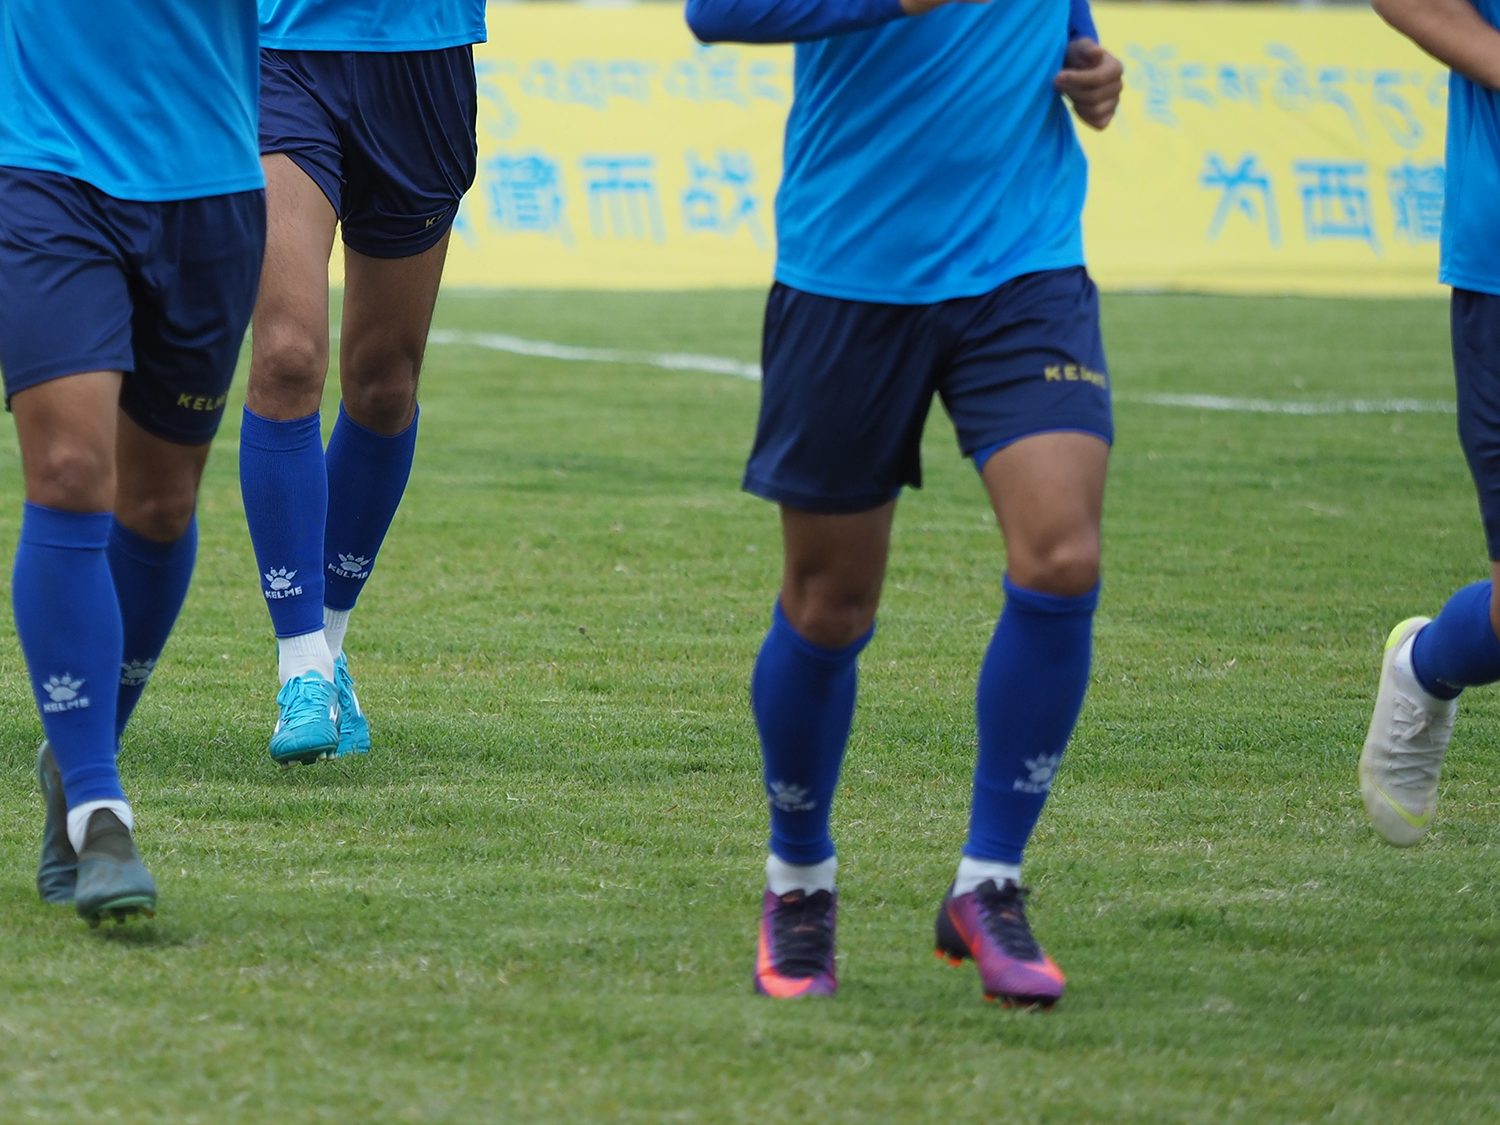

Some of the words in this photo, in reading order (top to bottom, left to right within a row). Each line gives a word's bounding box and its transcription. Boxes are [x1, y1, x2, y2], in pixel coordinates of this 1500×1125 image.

[452, 148, 770, 250] 藏而战
[327, 563, 368, 580] KELME
[265, 586, 303, 599] KELME
[43, 697, 90, 714] KELME
